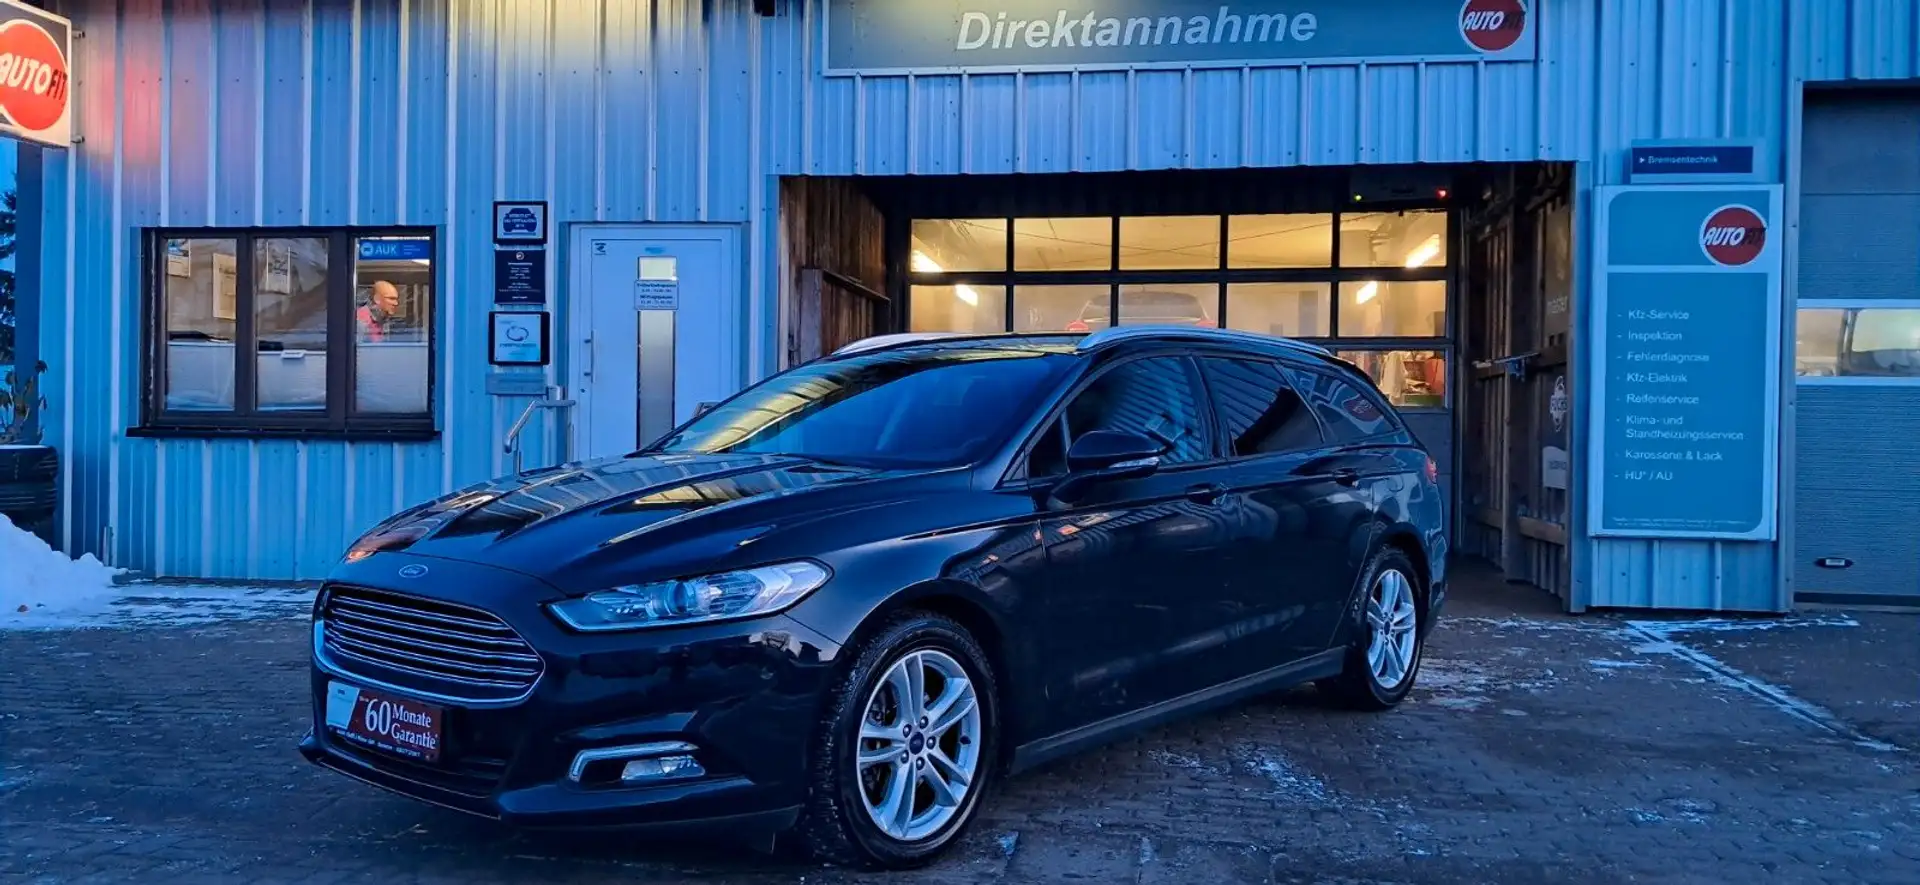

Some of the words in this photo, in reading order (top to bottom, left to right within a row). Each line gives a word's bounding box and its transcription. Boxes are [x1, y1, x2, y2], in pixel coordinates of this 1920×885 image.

[956, 5, 1318, 51] Direktannahme
[374, 243, 397, 256] AUK
[1628, 309, 1690, 320] Kfz-Service
[1628, 330, 1683, 342] Inspektion
[1663, 415, 1684, 425] und
[1696, 451, 1724, 461] Lack
[365, 699, 391, 735] 60
[392, 703, 432, 728] Monate
